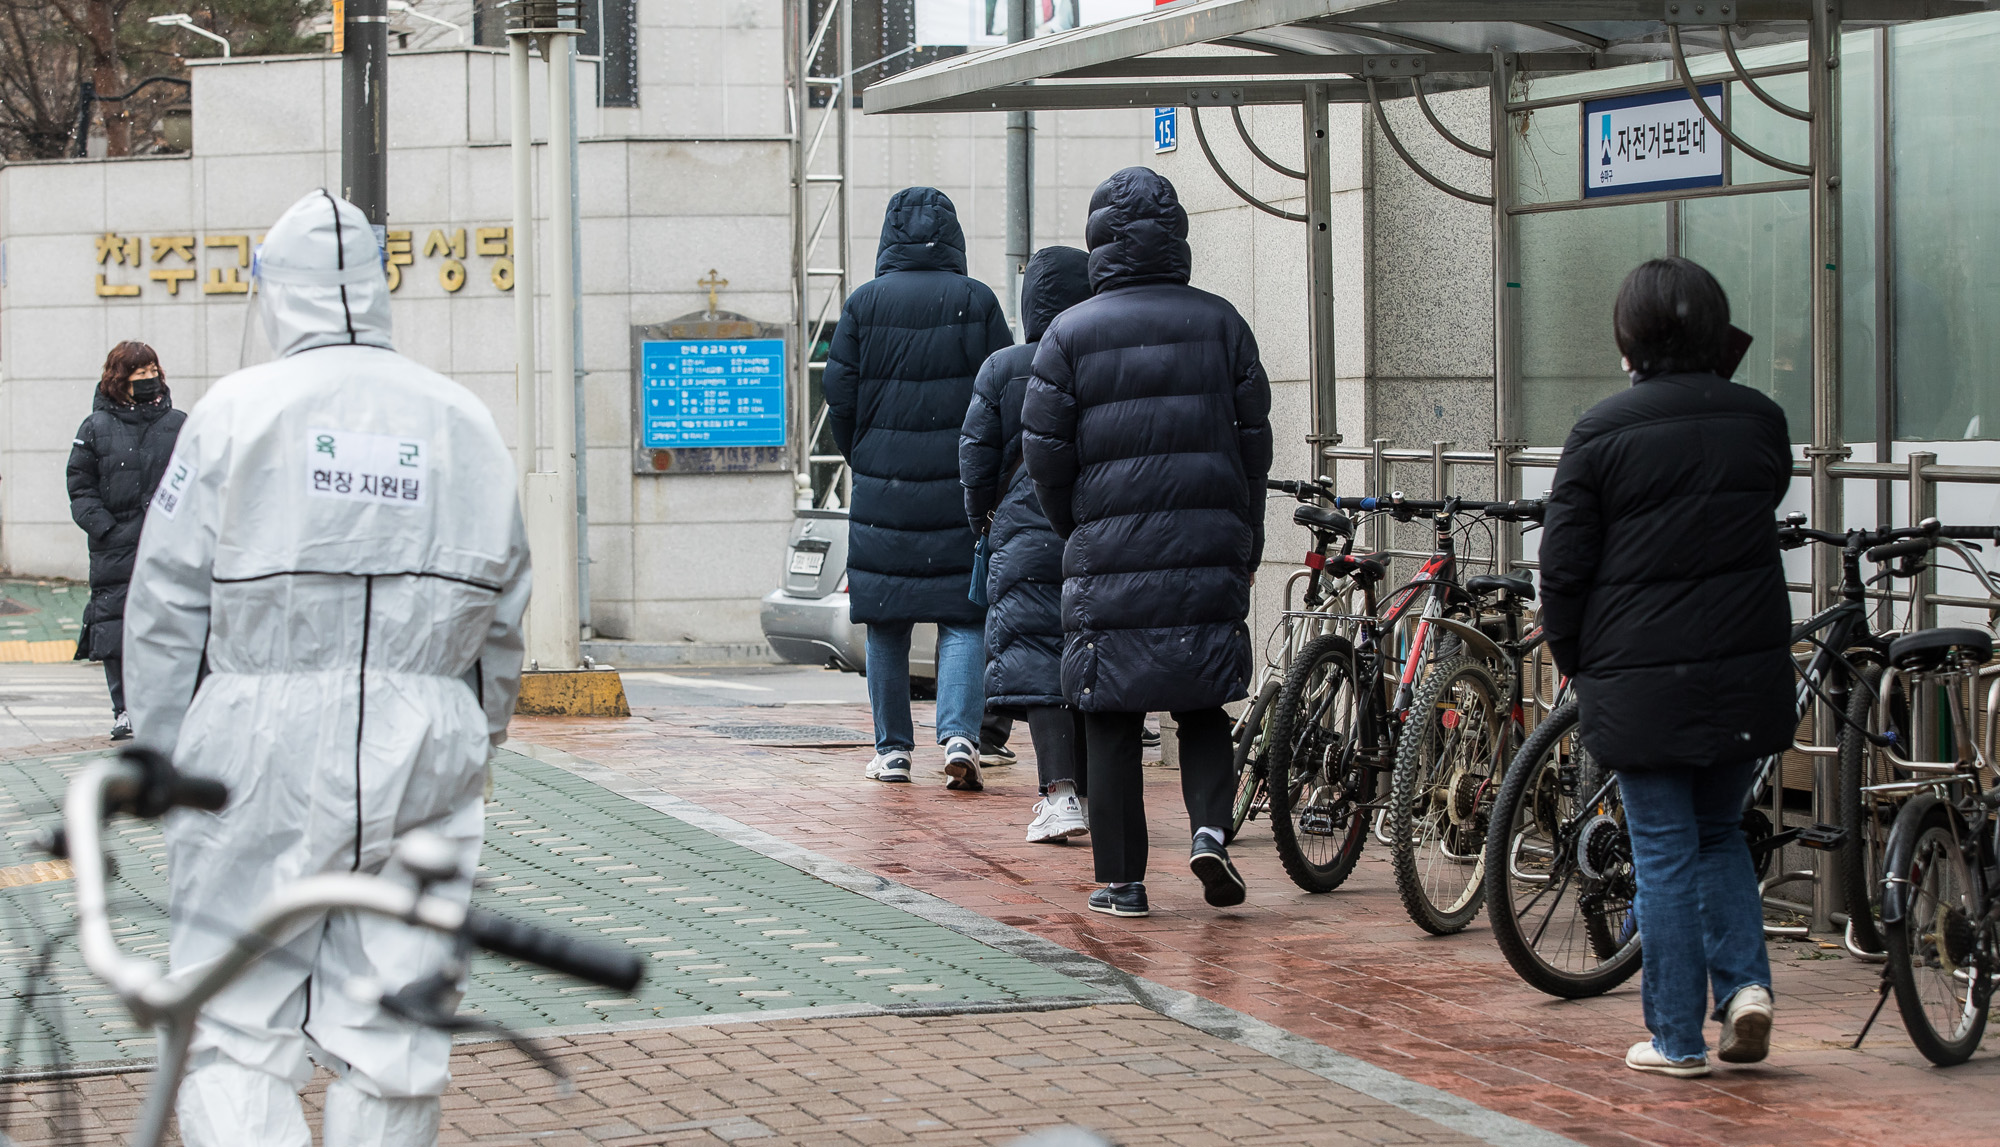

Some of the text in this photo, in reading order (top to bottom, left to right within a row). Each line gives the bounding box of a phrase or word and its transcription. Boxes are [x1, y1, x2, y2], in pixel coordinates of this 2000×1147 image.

[1158, 120, 1171, 144] 15
[1617, 116, 1706, 163] 자전거보관대
[1600, 169, 1613, 184] 송파구
[94, 232, 251, 297] 천주교
[316, 434, 420, 467] 육 군
[313, 469, 419, 500] 현장 지원팀
